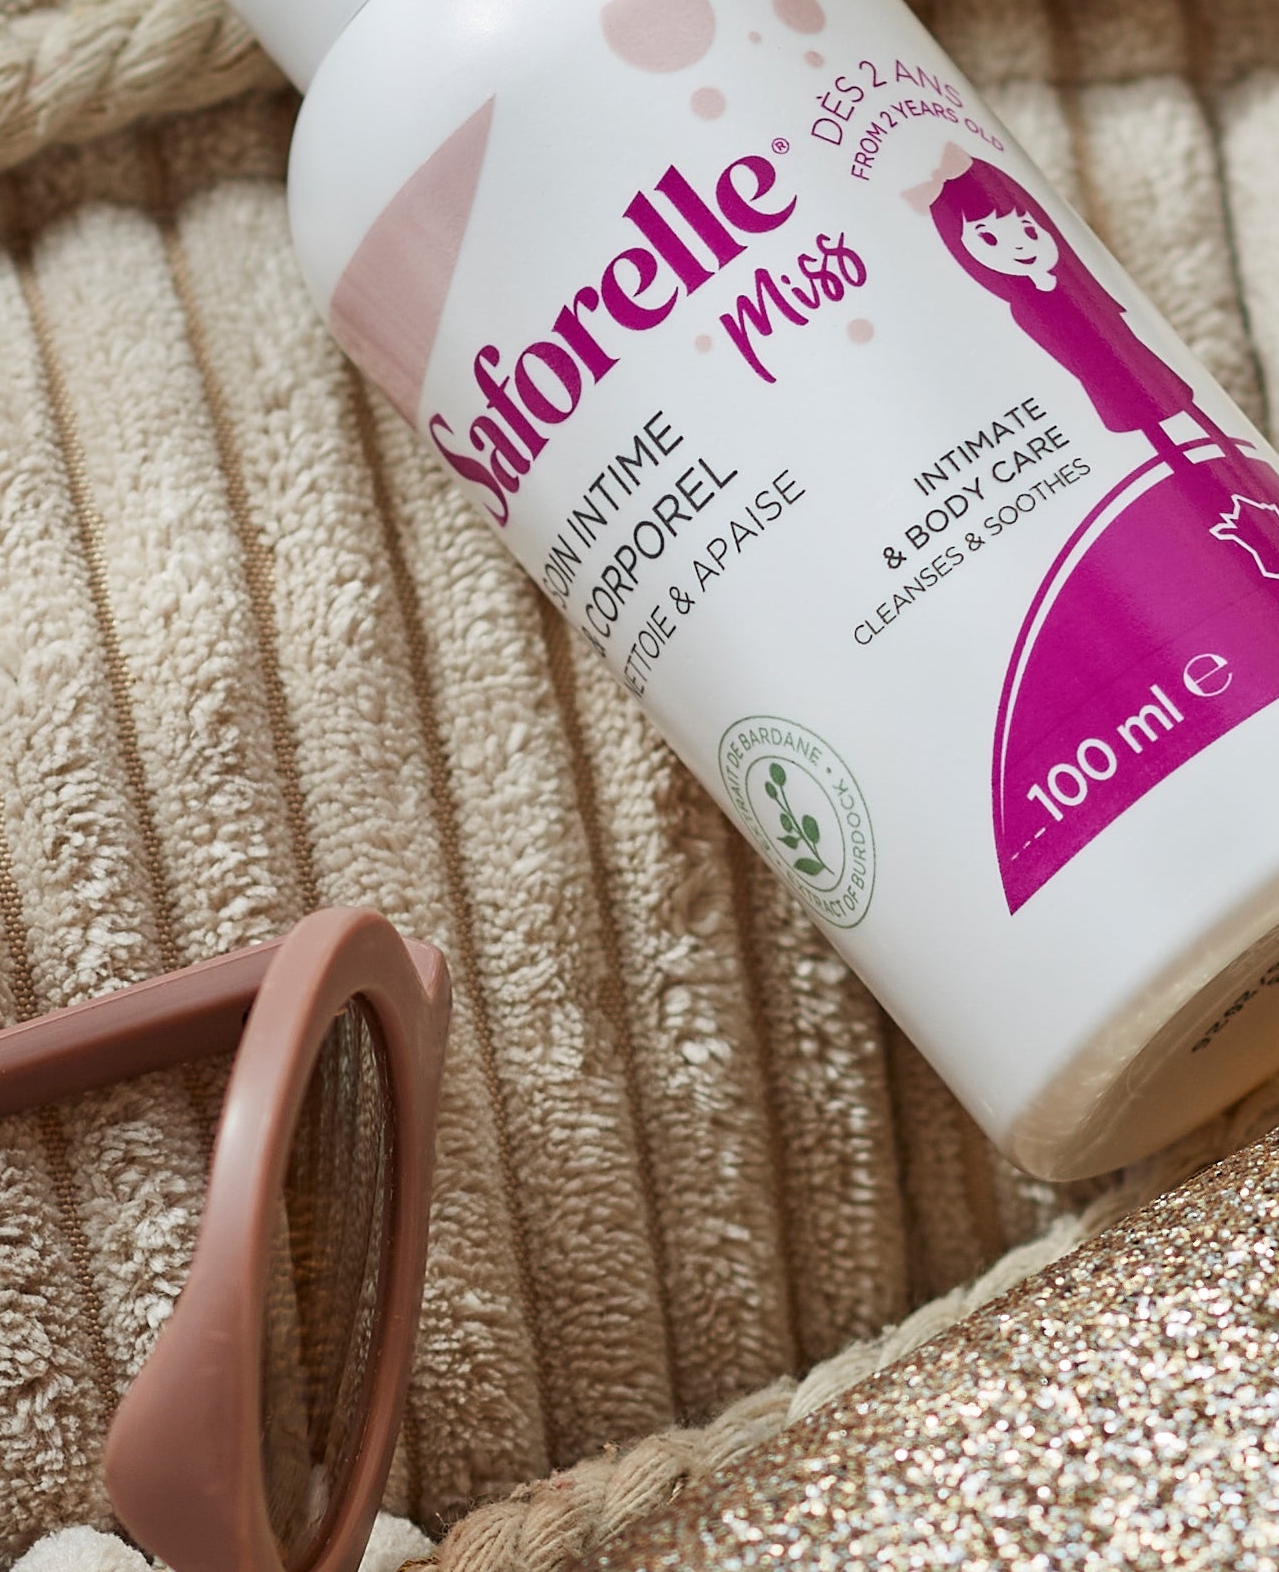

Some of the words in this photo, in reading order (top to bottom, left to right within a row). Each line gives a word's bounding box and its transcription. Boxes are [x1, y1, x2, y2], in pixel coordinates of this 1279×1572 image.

[811, 76, 864, 146] DÈS
[858, 60, 887, 88] 2
[894, 59, 963, 108] ANS
[851, 122, 888, 181] FROM
[879, 111, 898, 128] 2
[891, 100, 959, 124] YEARS
[963, 118, 1005, 152] OLD
[719, 231, 868, 384] Miss
[542, 534, 582, 610] SOIN
[567, 410, 684, 548] INTIME
[882, 546, 907, 570] &
[904, 477, 985, 551] BODY
[991, 425, 1071, 483] CARE
[913, 397, 1047, 496] INTIMATE
[585, 458, 739, 638] CORPOREL
[669, 586, 696, 615] &
[693, 469, 807, 592] APAISE
[854, 546, 965, 645] CLEANSES
[964, 532, 986, 552] &
[983, 458, 1092, 536] SOOTHES
[726, 742, 744, 769] DE
[738, 727, 822, 766] BARDANE
[1027, 738, 1118, 822] 100
[1116, 684, 1185, 754] ml
[832, 779, 866, 890] BURDOCK
[843, 884, 859, 911] OF
